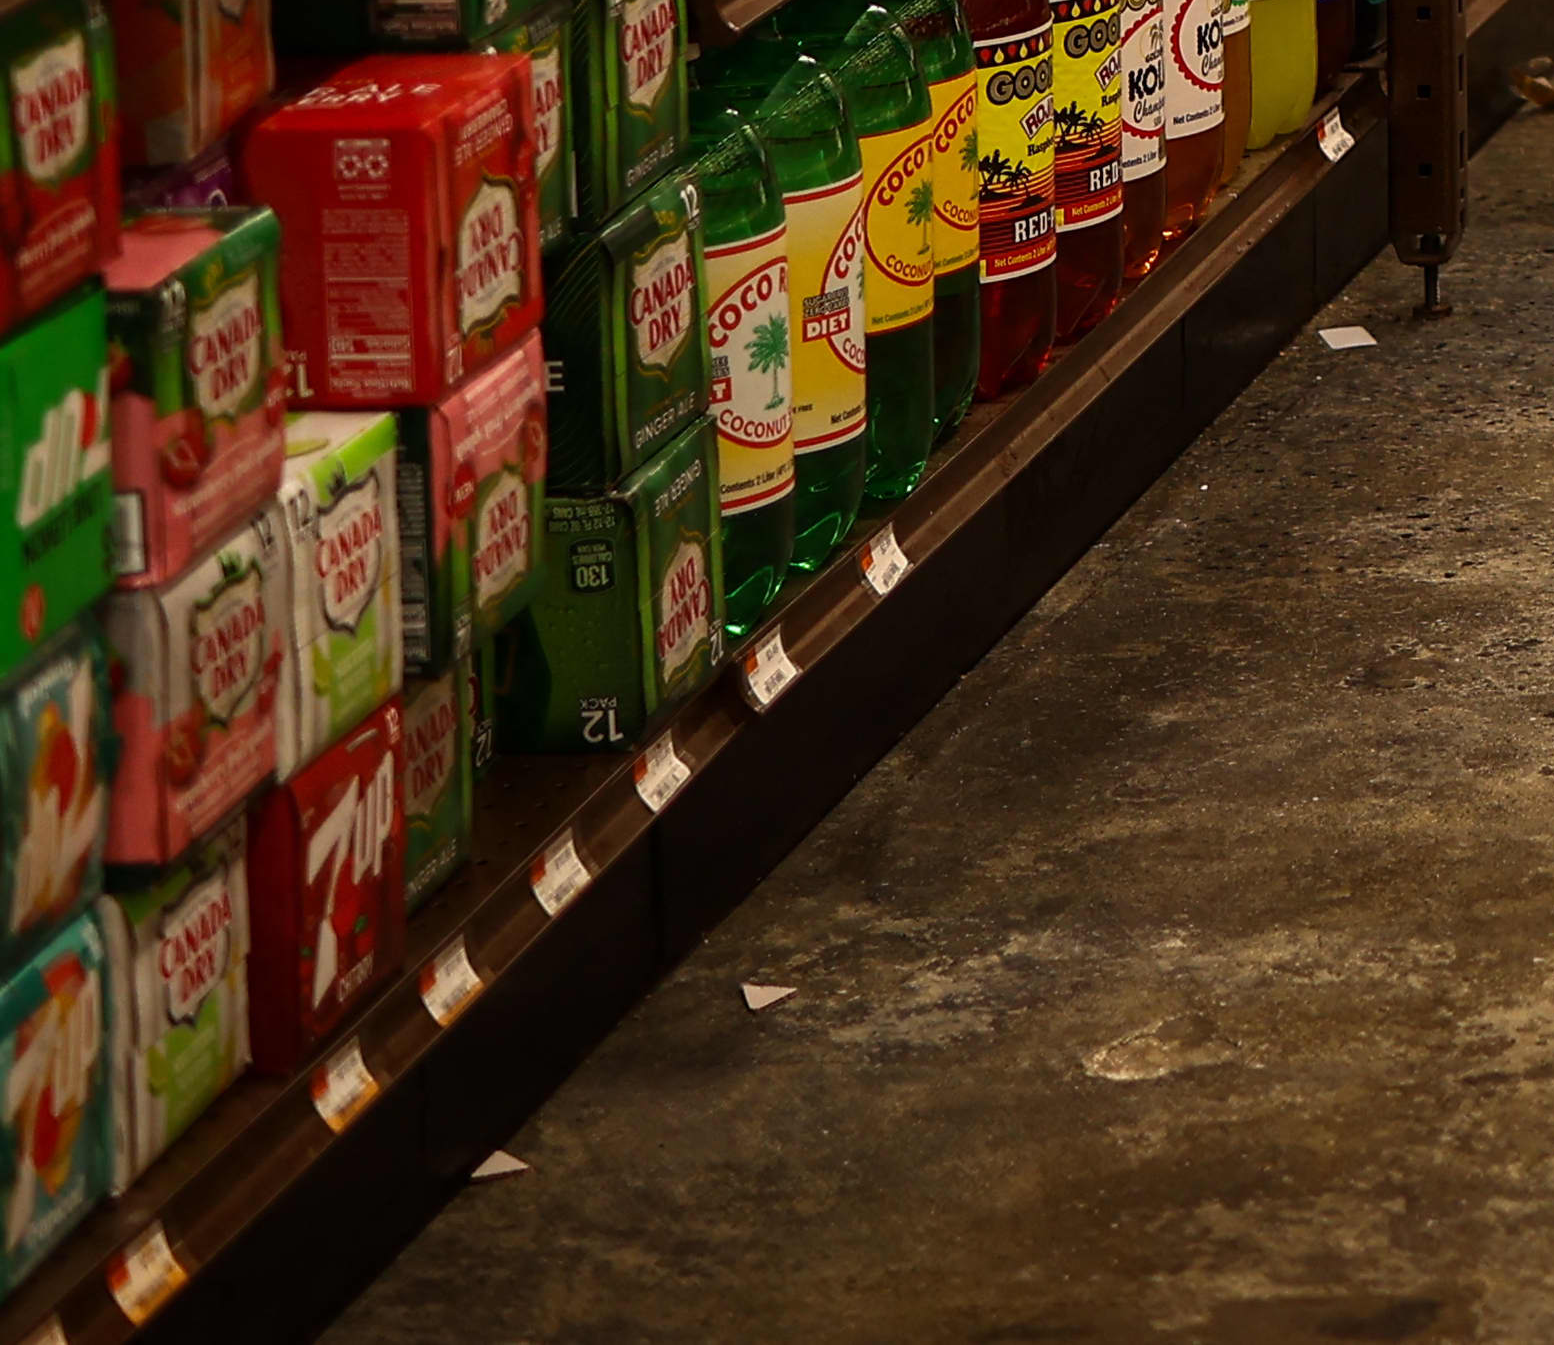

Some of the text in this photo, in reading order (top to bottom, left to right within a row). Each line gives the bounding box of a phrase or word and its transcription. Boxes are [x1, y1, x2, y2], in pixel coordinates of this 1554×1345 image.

[636, 42, 665, 89] DRY
[877, 148, 925, 206] COCO
[680, 184, 699, 219] 12
[630, 257, 694, 327] CANADA
[709, 274, 772, 348] COCO
[649, 307, 682, 353] DRY
[806, 313, 849, 340] DIET
[576, 564, 609, 588] 130
[670, 557, 696, 606] DRY
[657, 579, 711, 657] CANADA
[581, 697, 617, 709] PACK
[581, 709, 624, 743] 12
